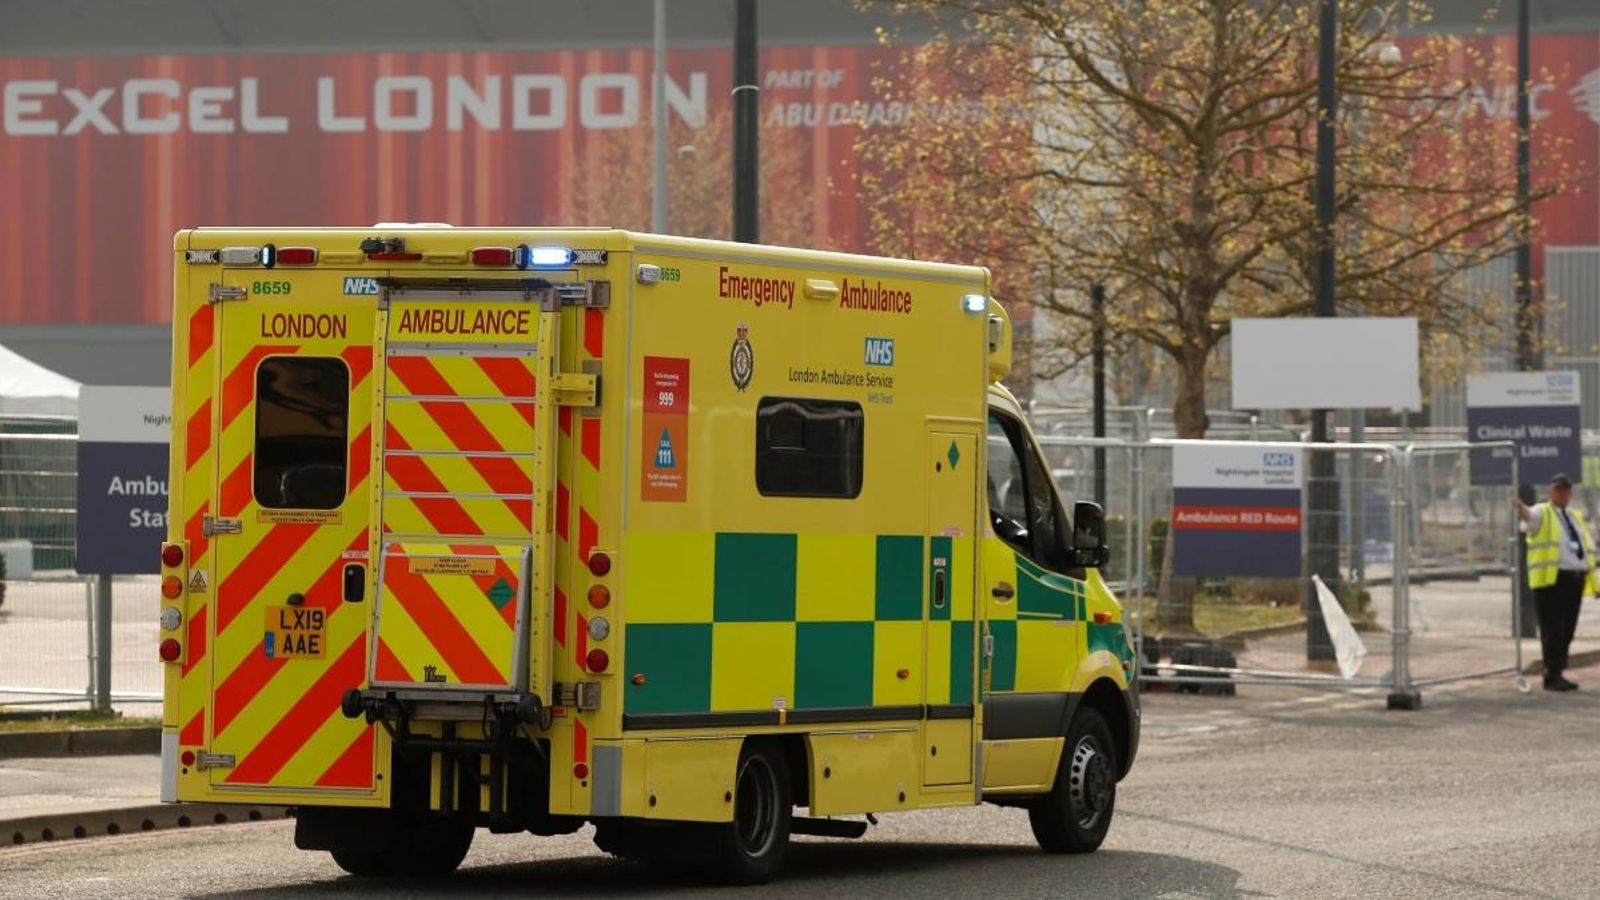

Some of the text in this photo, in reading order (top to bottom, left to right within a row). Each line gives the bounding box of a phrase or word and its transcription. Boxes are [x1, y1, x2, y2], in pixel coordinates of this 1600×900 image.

[764, 69, 845, 88] PART OF
[317, 73, 707, 132] LONDON
[766, 101, 822, 127] ABU
[252, 281, 291, 295] 8659
[344, 278, 379, 294] NHS
[719, 266, 912, 314] Emergency Ambulance
[261, 313, 347, 338] LONDON
[398, 309, 530, 335] AMBULANCE
[865, 339, 893, 364] NHS
[788, 367, 893, 388] London Ambulance Service
[659, 391, 674, 406] 999
[1477, 426, 1572, 439] Clinical Waste
[658, 449, 672, 464] 111
[1521, 445, 1559, 458] Linen
[1177, 511, 1298, 524] Ambulance RED Route
[280, 610, 323, 630] LX19
[283, 633, 320, 654] AAE
